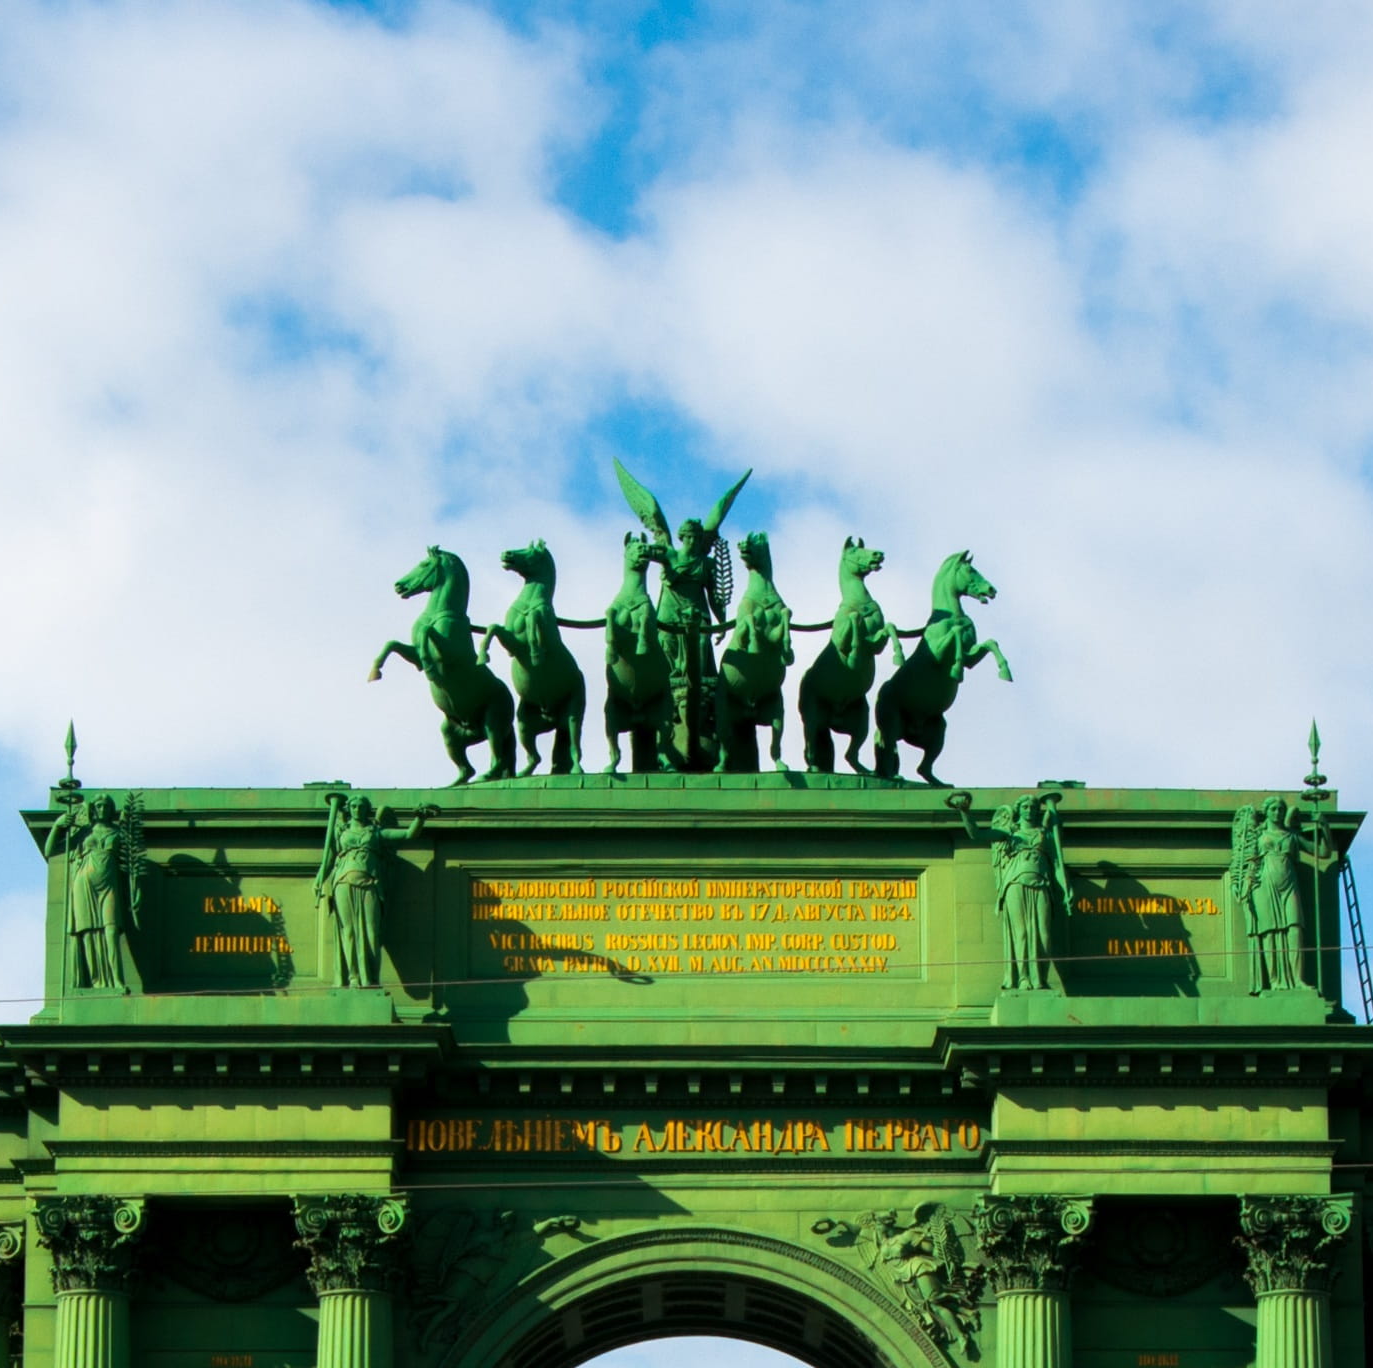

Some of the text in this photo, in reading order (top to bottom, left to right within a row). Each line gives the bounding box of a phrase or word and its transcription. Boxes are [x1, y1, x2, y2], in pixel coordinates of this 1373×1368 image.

[706, 878, 842, 898] ИМПЕРАТОРСКОЙ
[472, 904, 611, 921] ПРИЗНАТЕЛЬНОЕ
[616, 904, 714, 920] ОТЕЧЕСТВО
[720, 904, 744, 920] ВЪ
[750, 904, 770, 920] 17
[792, 904, 866, 921] АВГУСТА
[605, 933, 679, 951] ROSSICIS
[746, 934, 777, 950] IMP.
[830, 934, 900, 951] CUSTOD.
[634, 1119, 831, 1155] АЛЕКСАНДРА
